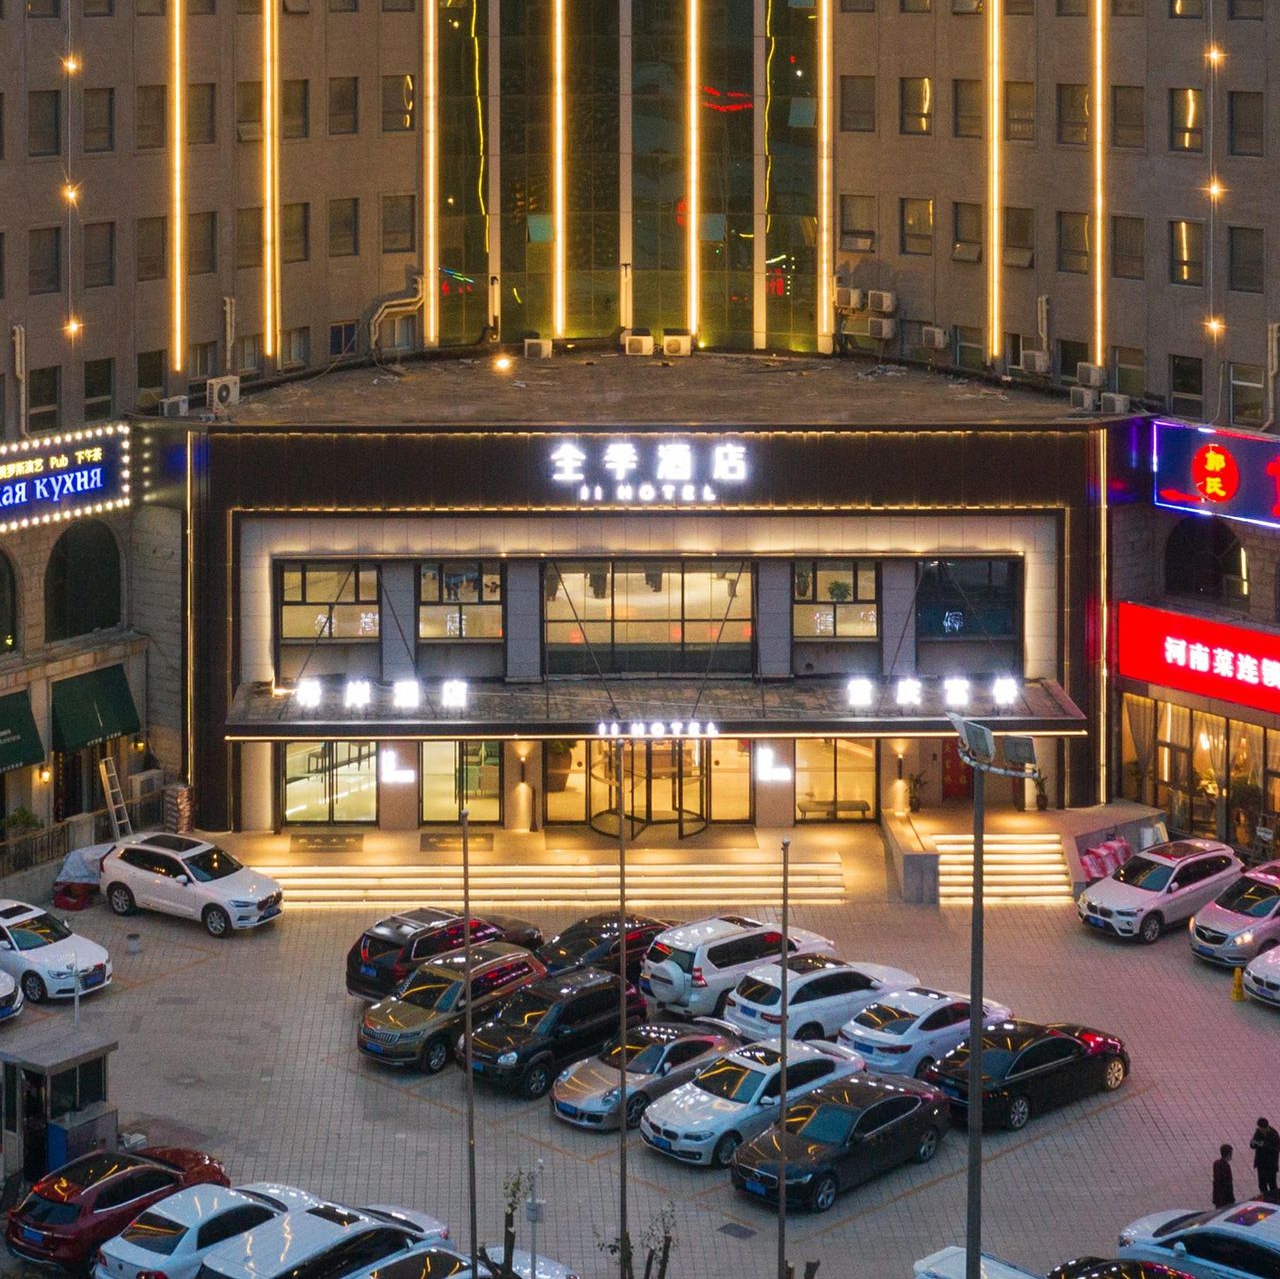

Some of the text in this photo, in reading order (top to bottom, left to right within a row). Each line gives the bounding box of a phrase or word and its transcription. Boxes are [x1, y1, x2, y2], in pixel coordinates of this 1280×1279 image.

[49, 454, 69, 470] Pub
[74, 447, 103, 465] 下午茶
[550, 443, 747, 481] 全季酒店
[617, 484, 717, 501] HOTEL
[631, 722, 719, 737] HOTEL
